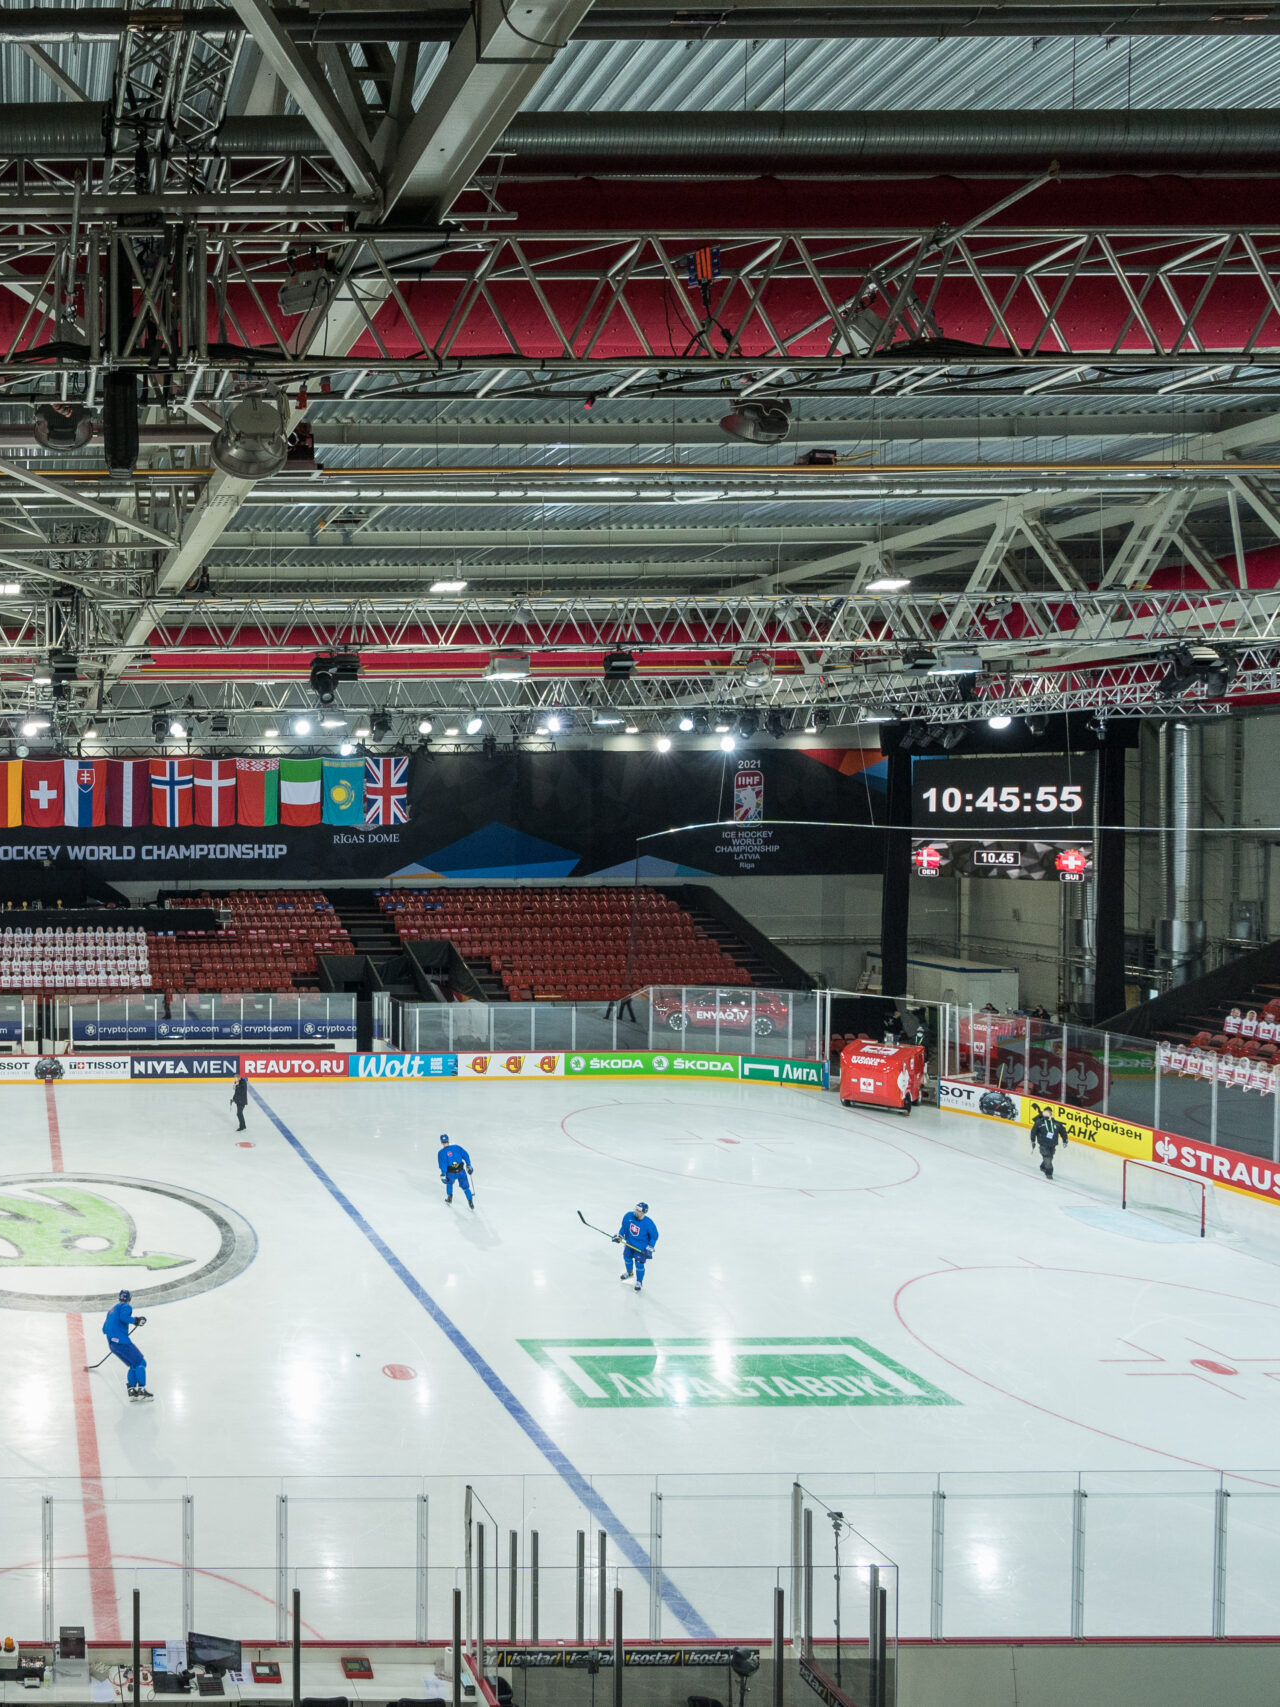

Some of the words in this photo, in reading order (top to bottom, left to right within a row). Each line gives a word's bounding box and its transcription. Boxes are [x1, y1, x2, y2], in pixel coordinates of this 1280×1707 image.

[738, 760, 761, 768] 2021
[738, 776, 760, 785] IIHF
[922, 786, 1083, 812] 10:45:55
[333, 832, 366, 844] RĪGAS
[368, 833, 400, 843] DOME
[738, 830, 774, 838] HOCKEY
[731, 838, 763, 846] WORLD
[66, 845, 136, 860] WORLD
[141, 844, 288, 860] CHAMPIONSHIP
[714, 845, 780, 854] CHAMPIONSHIP
[980, 852, 1015, 864] 10.45
[922, 868, 936, 876] DEN
[696, 1010, 736, 1021] ENYAQ
[98, 1025, 146, 1034] crypto.com
[172, 1025, 220, 1034] crypto.com
[244, 1024, 292, 1034] crypto.com
[317, 1024, 357, 1032] crypto.co
[86, 1061, 128, 1070] TISSOT
[134, 1060, 188, 1074] NIVEA
[193, 1060, 237, 1074] MEN
[244, 1059, 344, 1074] REAUTO.RU
[358, 1054, 424, 1077] Wolt
[590, 1058, 644, 1070] ŠKODA
[673, 1058, 734, 1072] ŠKODA
[1058, 1106, 1142, 1141] Райффайзен
[629, 1652, 676, 1664] isostar
[688, 1652, 732, 1664] isosta
